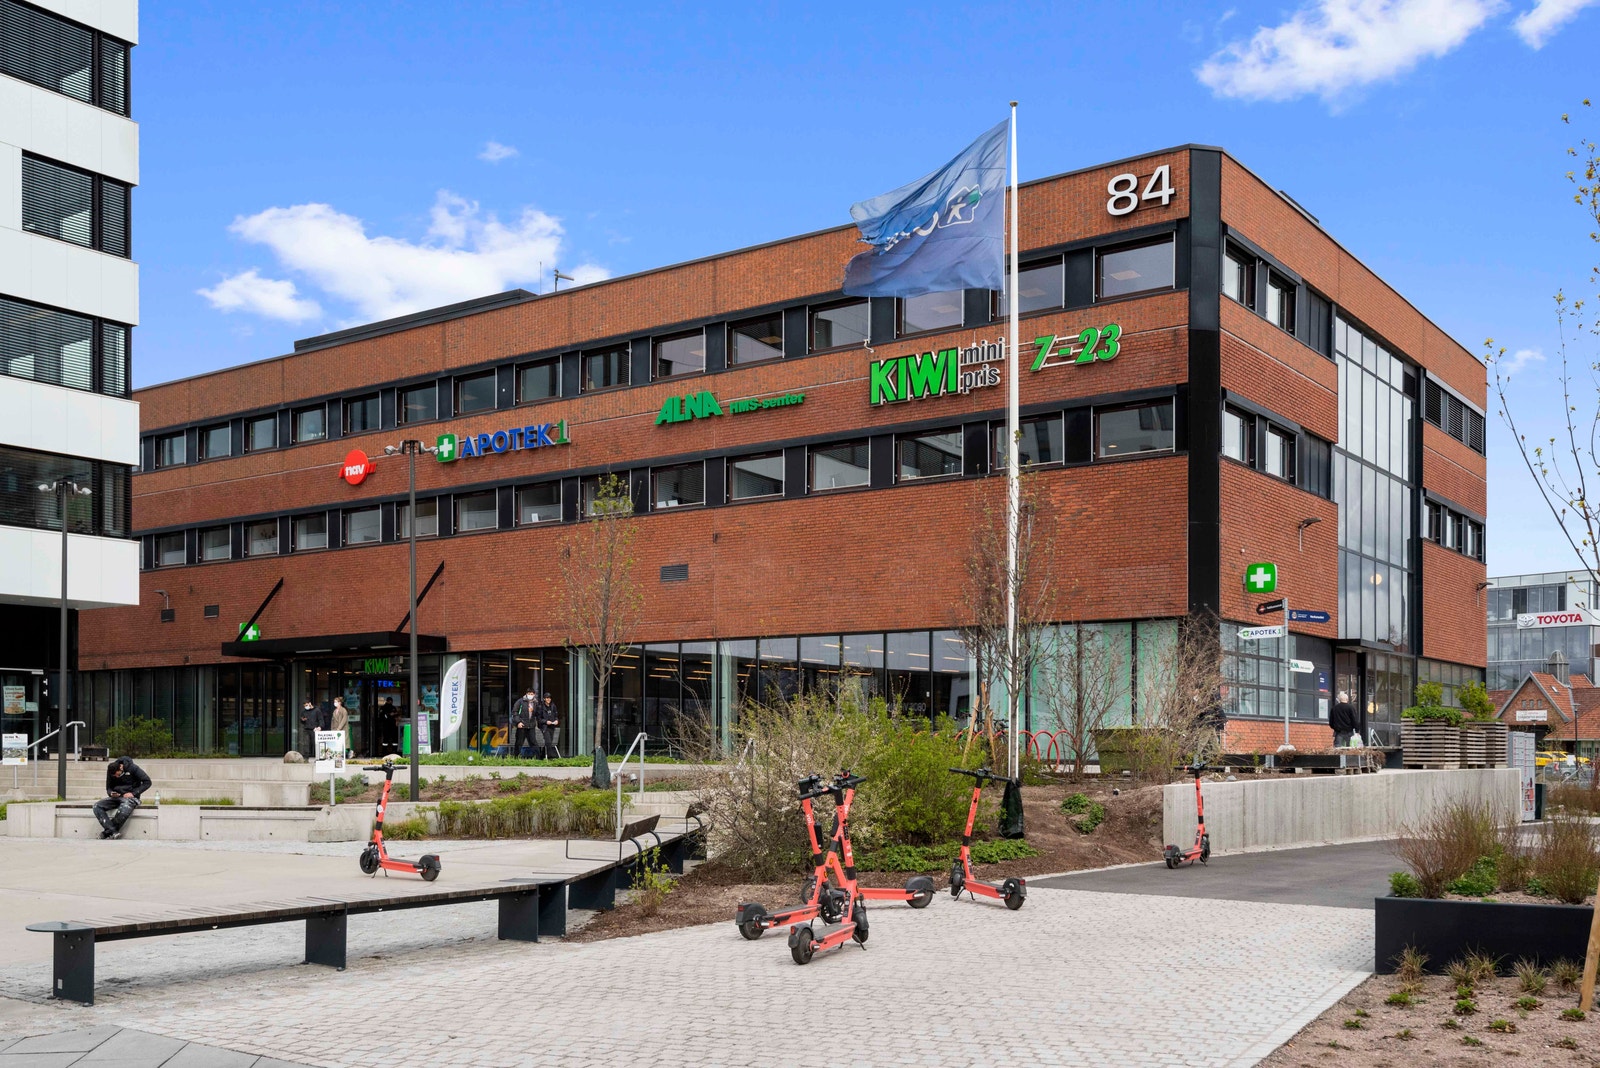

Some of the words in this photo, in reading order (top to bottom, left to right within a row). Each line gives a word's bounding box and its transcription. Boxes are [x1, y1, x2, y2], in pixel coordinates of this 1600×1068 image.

[1107, 164, 1175, 216] 84
[962, 337, 1005, 364] mini
[1030, 323, 1122, 372] 7-23
[869, 346, 961, 407] KIWI
[962, 364, 1000, 394] pris
[654, 390, 724, 425] ALNA
[729, 393, 806, 415] HMS-senter
[461, 423, 553, 459] APOTEK
[1537, 613, 1583, 625] TOYOTA
[364, 657, 389, 674] KIWI
[451, 681, 459, 715] APOTEK
